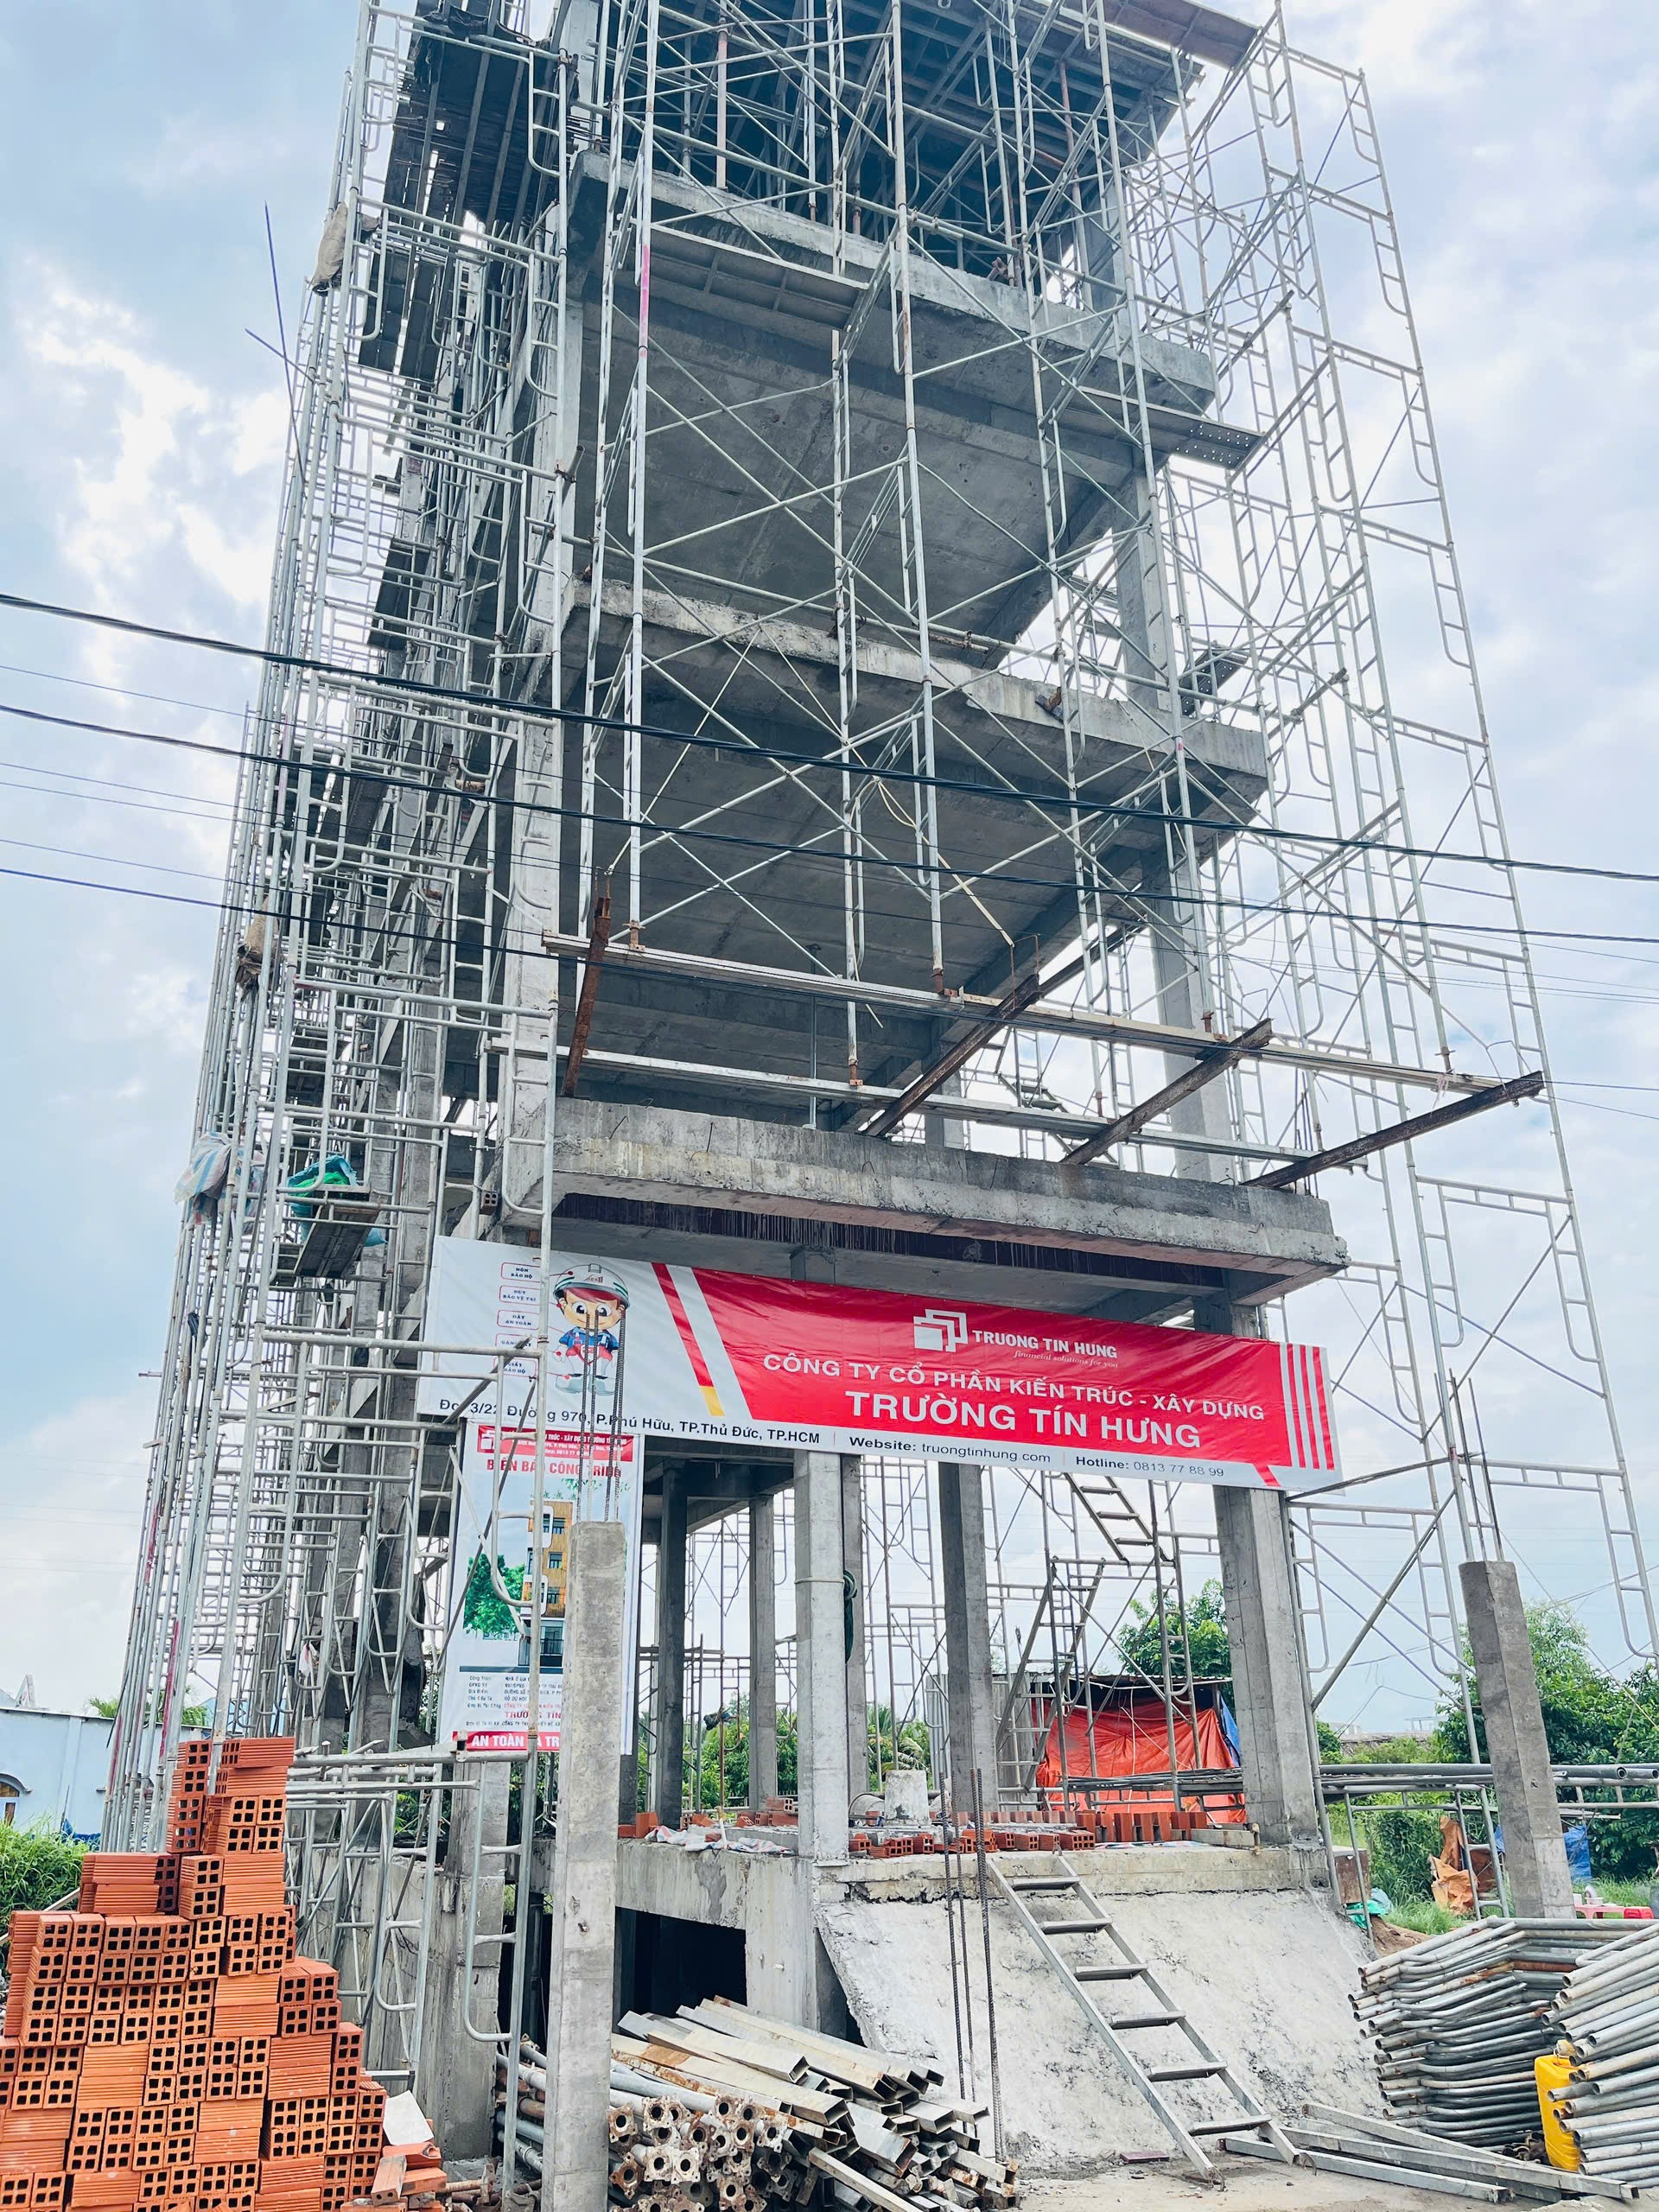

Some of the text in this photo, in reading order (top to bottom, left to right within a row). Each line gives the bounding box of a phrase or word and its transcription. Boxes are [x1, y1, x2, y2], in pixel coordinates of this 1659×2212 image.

[972, 1330, 1118, 1358] TRUONG TIN HUNG
[1014, 1350, 1052, 1361] financial
[1052, 1355, 1088, 1365] solutions
[763, 1353, 840, 1376] CÔNG
[849, 1363, 880, 1380] TY
[889, 1361, 925, 1384] CỔ
[934, 1369, 1001, 1393] PHẦN
[1009, 1376, 1065, 1398] KIẾN
[1071, 1385, 1133, 1407] TRÚC
[1153, 1393, 1195, 1413] XÂY
[1202, 1401, 1265, 1421] DỰNG
[642, 1417, 674, 1433] Hữu,
[679, 1421, 728, 1436] TP.Thủ
[732, 1426, 762, 1440] Đức,
[767, 1428, 820, 1444] TP.HCM
[845, 1390, 1200, 1448] TRƯỜNG TÍN HƯNG
[849, 1436, 1051, 1463] Website: truongtinhung.com
[1076, 1456, 1224, 1477] Hotline: 0813 77 88 99
[472, 1735, 489, 1747] AN
[493, 1733, 524, 1747] TOÀN
